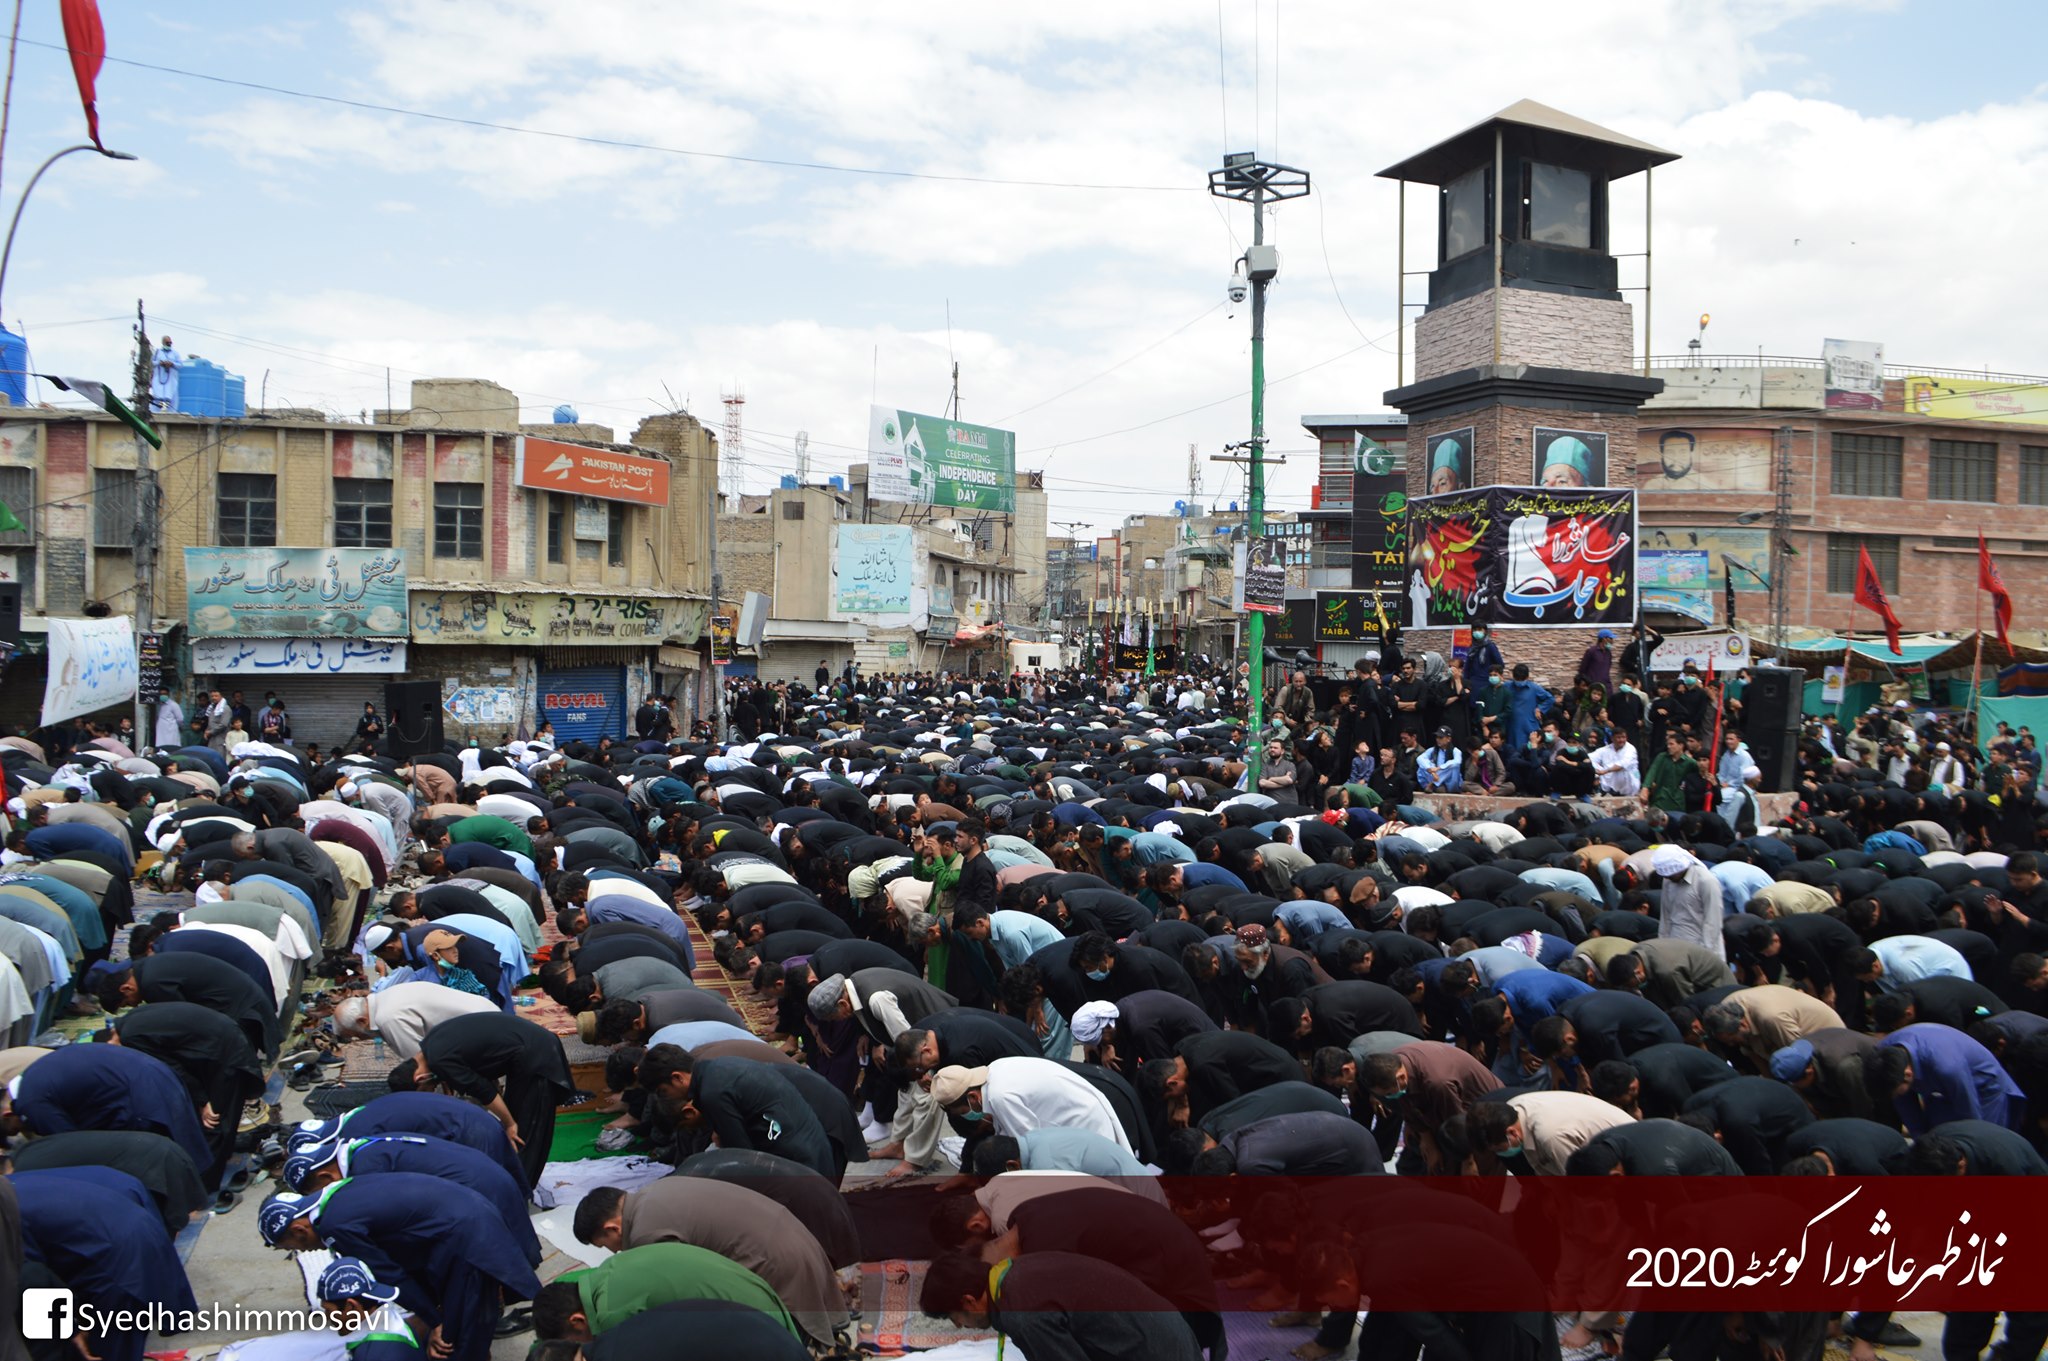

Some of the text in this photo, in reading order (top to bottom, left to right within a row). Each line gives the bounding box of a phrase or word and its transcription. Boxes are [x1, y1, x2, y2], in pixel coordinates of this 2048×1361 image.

[582, 457, 654, 477] PAKISTAN POST
[945, 448, 991, 464] CELEBRATING
[939, 463, 997, 486] INDEPENDENCE
[957, 488, 978, 503] DAY
[1552, 518, 1631, 563] عاشورا
[1372, 551, 1405, 564] TAI
[194, 561, 245, 593] سٹور
[244, 558, 297, 601] ملک
[319, 555, 341, 601] ٹی
[342, 555, 400, 601] نیشنل
[1594, 570, 1626, 611] یعنی
[1363, 599, 1397, 609] Birani
[1466, 576, 1489, 616] یعنی
[1503, 569, 1599, 619] حجاب
[584, 597, 652, 619] PARIS
[620, 624, 647, 637] COMP
[226, 643, 257, 669] سٹور
[253, 640, 299, 668] ملک
[306, 640, 323, 670] ٹی
[327, 640, 397, 672] نیشنل
[545, 693, 606, 709] ROYAL
[567, 713, 587, 722] FANS
